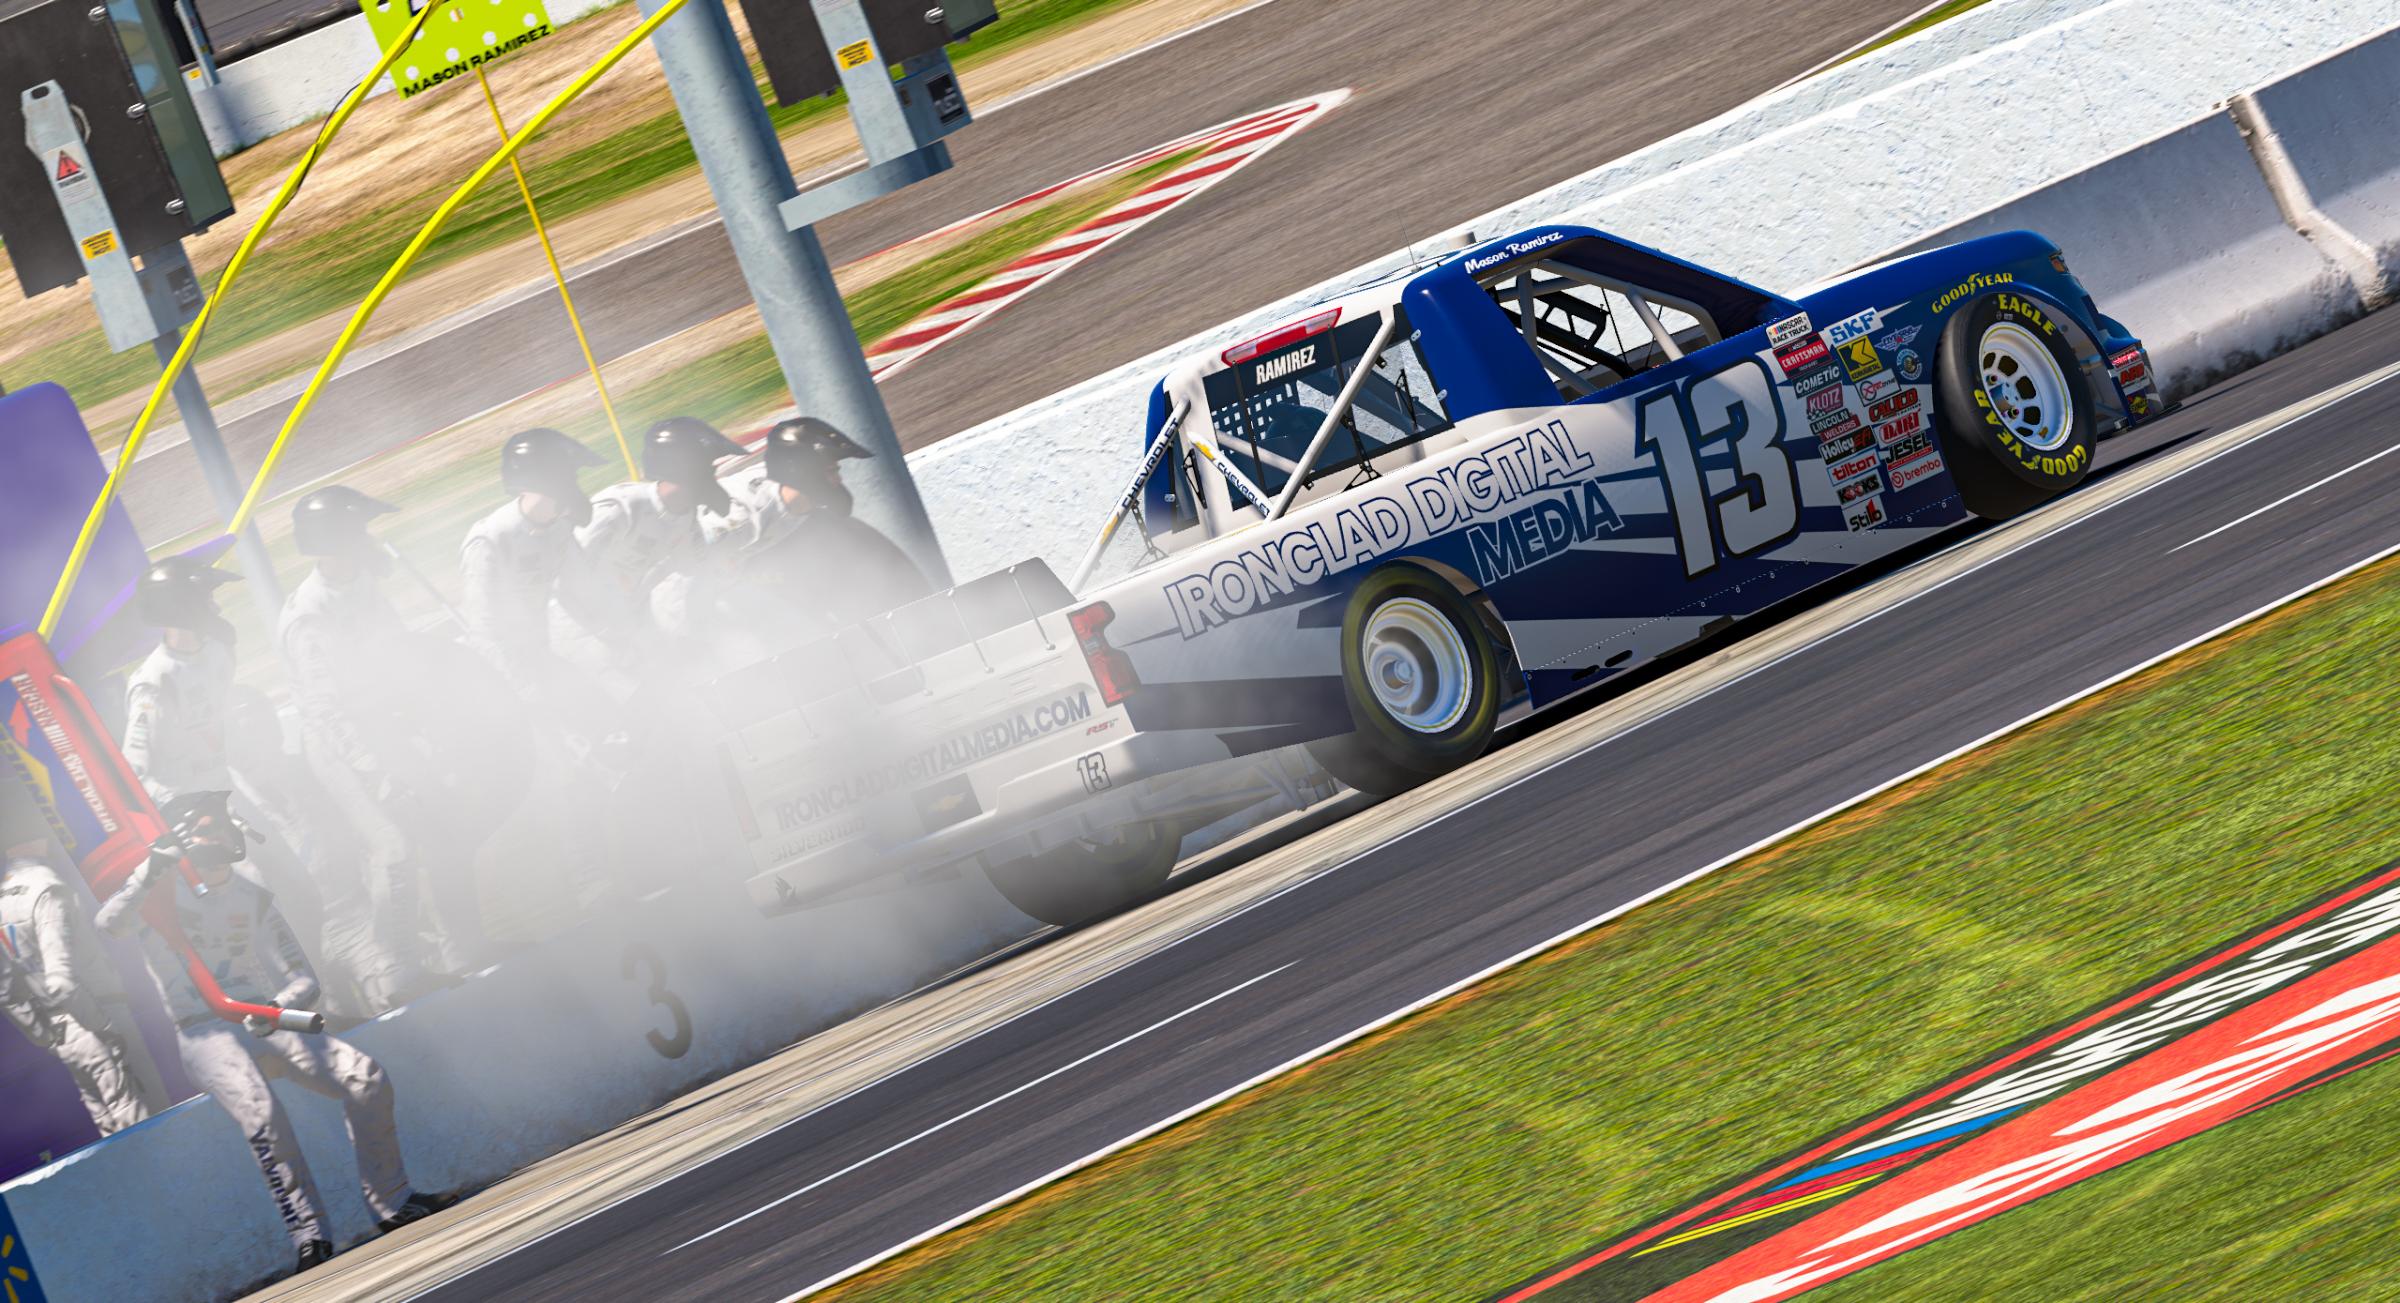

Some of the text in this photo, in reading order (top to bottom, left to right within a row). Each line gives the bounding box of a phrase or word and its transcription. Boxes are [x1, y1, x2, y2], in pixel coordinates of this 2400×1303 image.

[403, 24, 551, 98] MASON RAMIREZ
[1464, 232, 1564, 275] Mason Ramirez
[1931, 272, 2014, 314] GOODYEAR
[1772, 324, 1809, 345] RACE TRUCK
[1829, 311, 1875, 344] SKF
[1998, 293, 2057, 336] EAGLE
[1255, 344, 1316, 386] RAMIREZ
[1781, 343, 1825, 368] CRAFTSMAN
[1808, 387, 1841, 413] KLOTZ
[1868, 387, 1919, 423] CALICO
[1812, 409, 1850, 434] LINCOLN
[1823, 420, 1857, 440] WELDERS
[1122, 417, 1179, 509] CHEVROLET
[1821, 436, 1855, 461] Holley
[1832, 453, 1878, 481] tilton
[1885, 431, 1932, 463] JESEL
[1217, 462, 1270, 516] CHEVROLET
[1637, 357, 1800, 581] 13
[1903, 459, 1941, 481] brembo
[1164, 419, 1595, 641] IRONCLAD DIGITAL
[1466, 477, 1625, 587] MEDIA
[1086, 718, 1119, 736] RST
[776, 690, 1092, 831] IRONCLADDIGITALMEDIA.COM
[1077, 751, 1113, 795] 13
[621, 941, 693, 1059] 3
